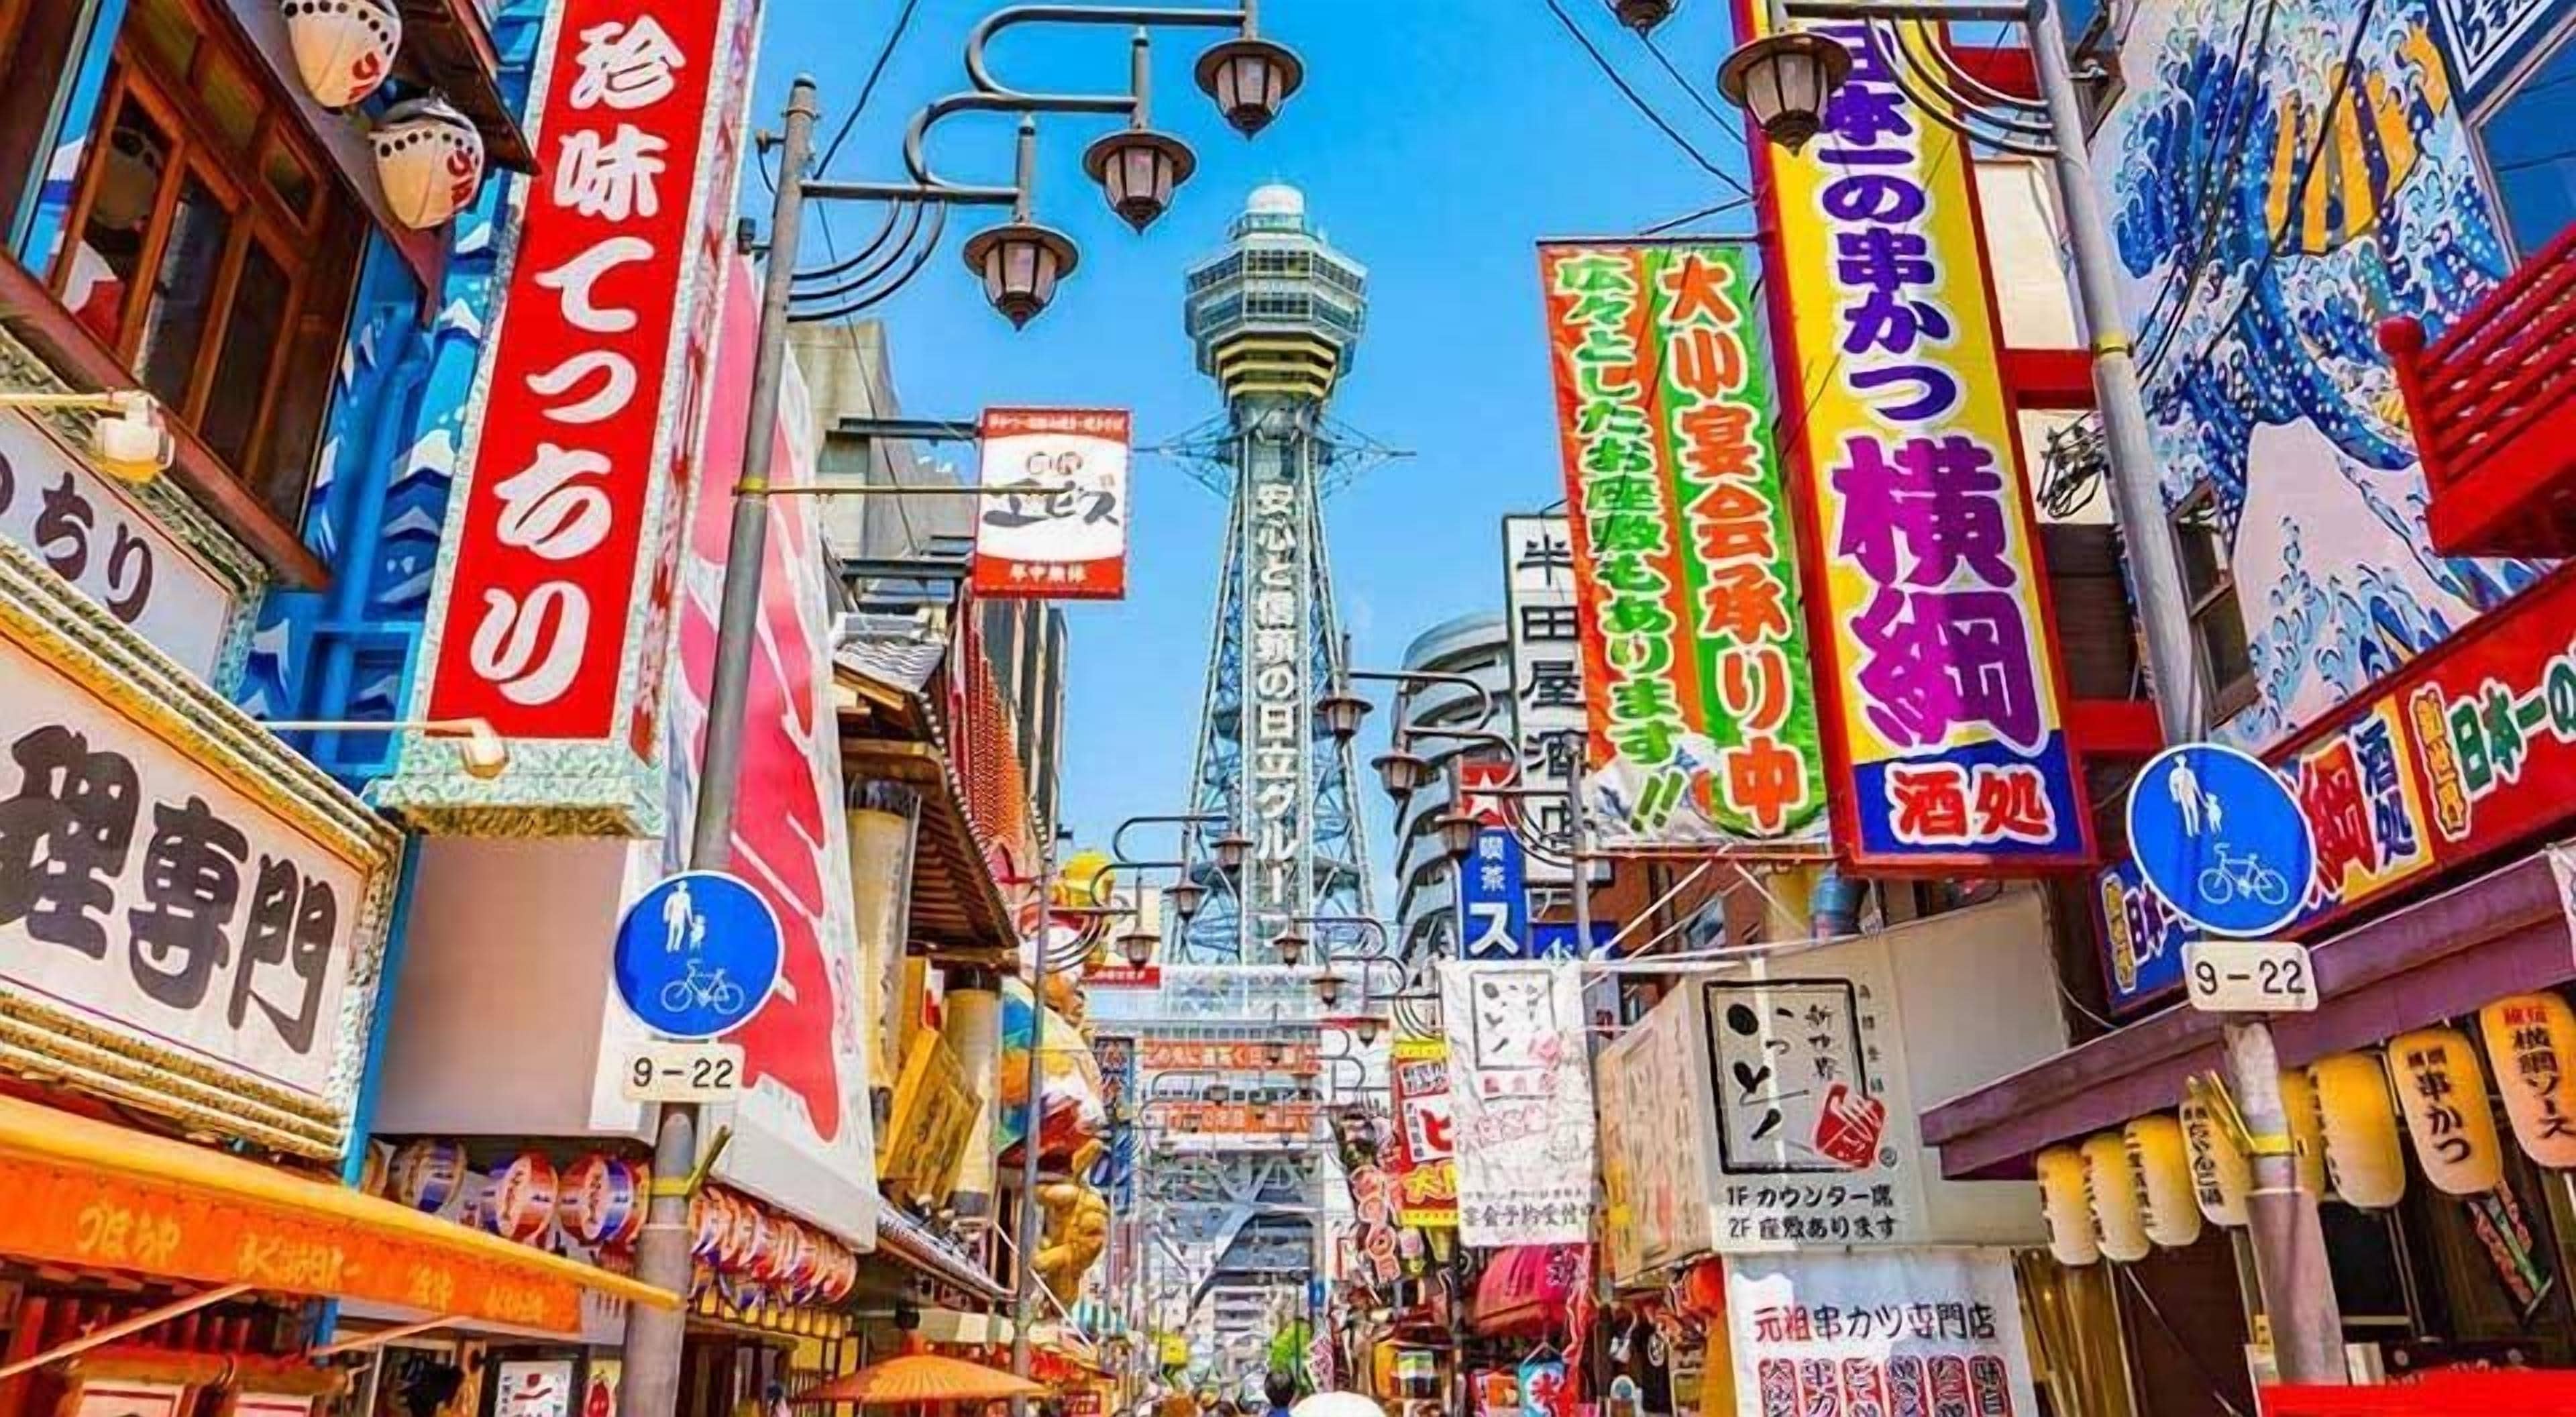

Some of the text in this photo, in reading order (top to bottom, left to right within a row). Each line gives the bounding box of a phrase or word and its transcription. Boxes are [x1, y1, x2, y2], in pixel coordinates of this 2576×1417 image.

[1805, 25, 1957, 423] 日本一の串かつ
[470, 13, 686, 704] 珍味てっちり
[0, 451, 153, 623] ちり
[1662, 252, 1807, 833] 大小宴会承り中
[1835, 435, 2041, 749] 横綱
[1893, 769, 2051, 840] 酒処
[2355, 718, 2416, 867] 酒処
[0, 725, 337, 1053] 理専門
[1469, 836, 1519, 955] 喫茶 ス
[2416, 1068, 2471, 1165] 串かつ
[1754, 1303, 1996, 1342] 元祖串カツ専門店
